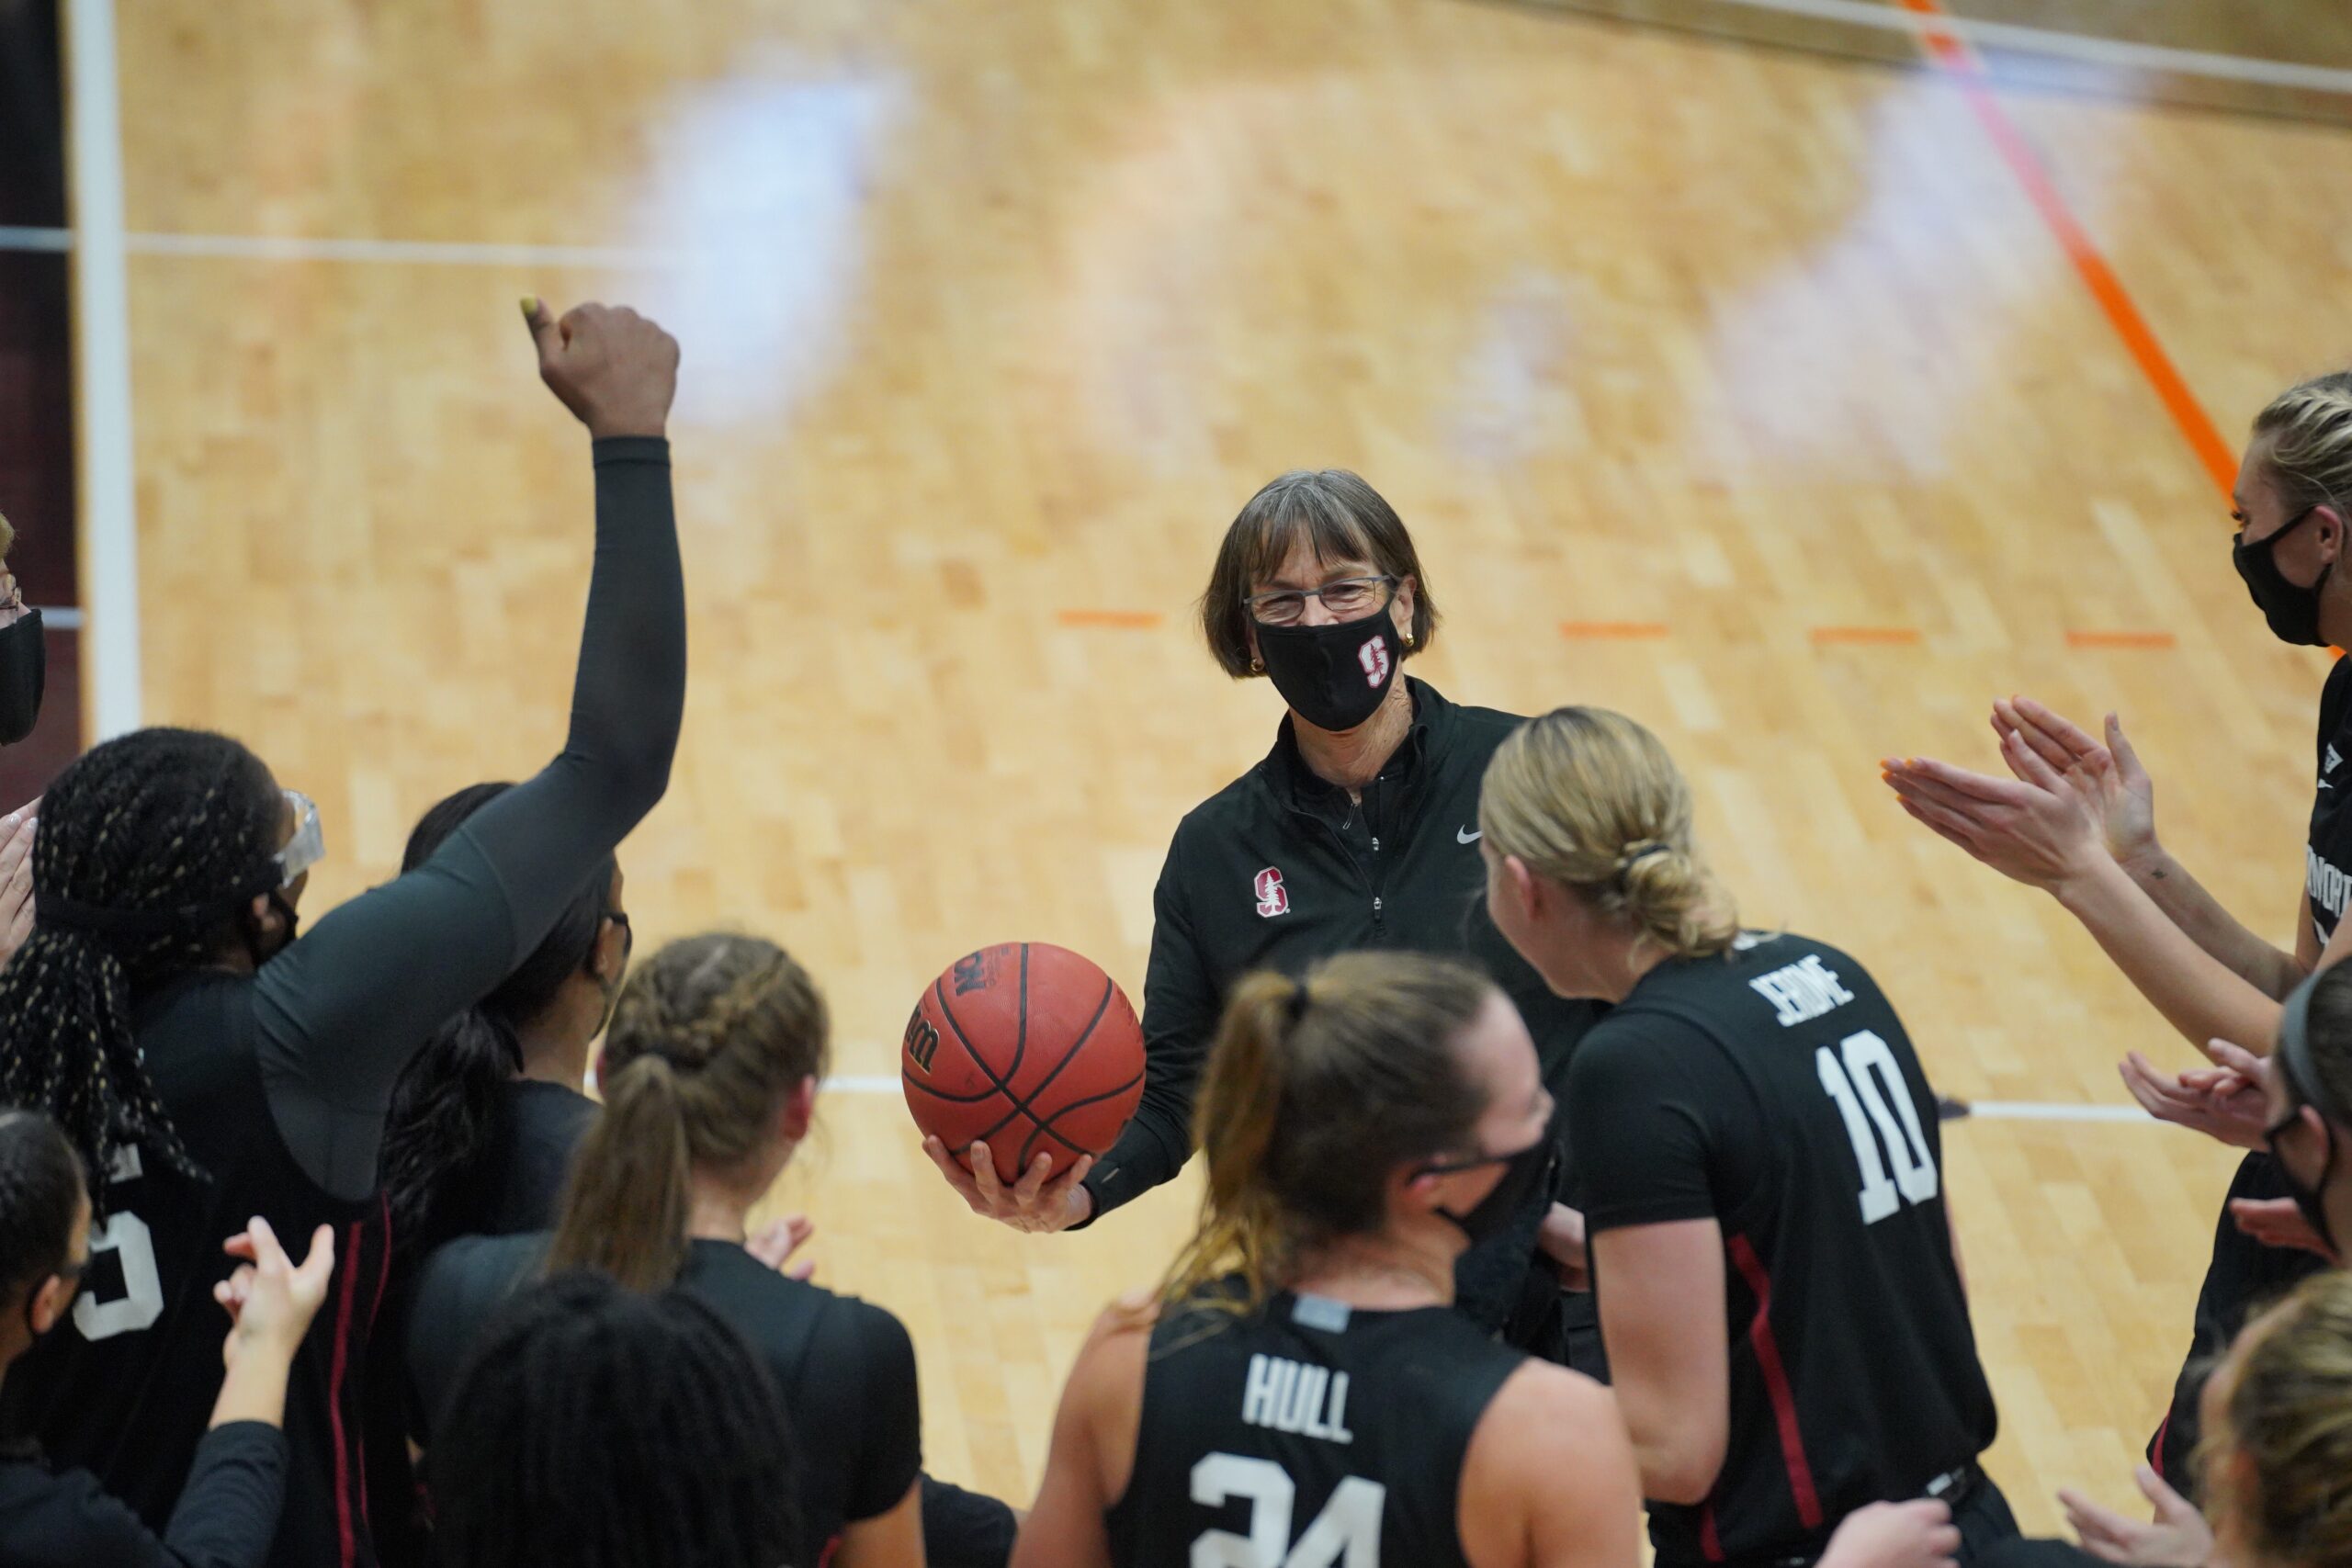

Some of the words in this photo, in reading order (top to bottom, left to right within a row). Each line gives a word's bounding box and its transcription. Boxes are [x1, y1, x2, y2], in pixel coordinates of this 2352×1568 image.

[1815, 1029, 1938, 1225] 10
[1242, 1353, 1353, 1444] HULL
[1190, 1450, 1386, 1568] 24
